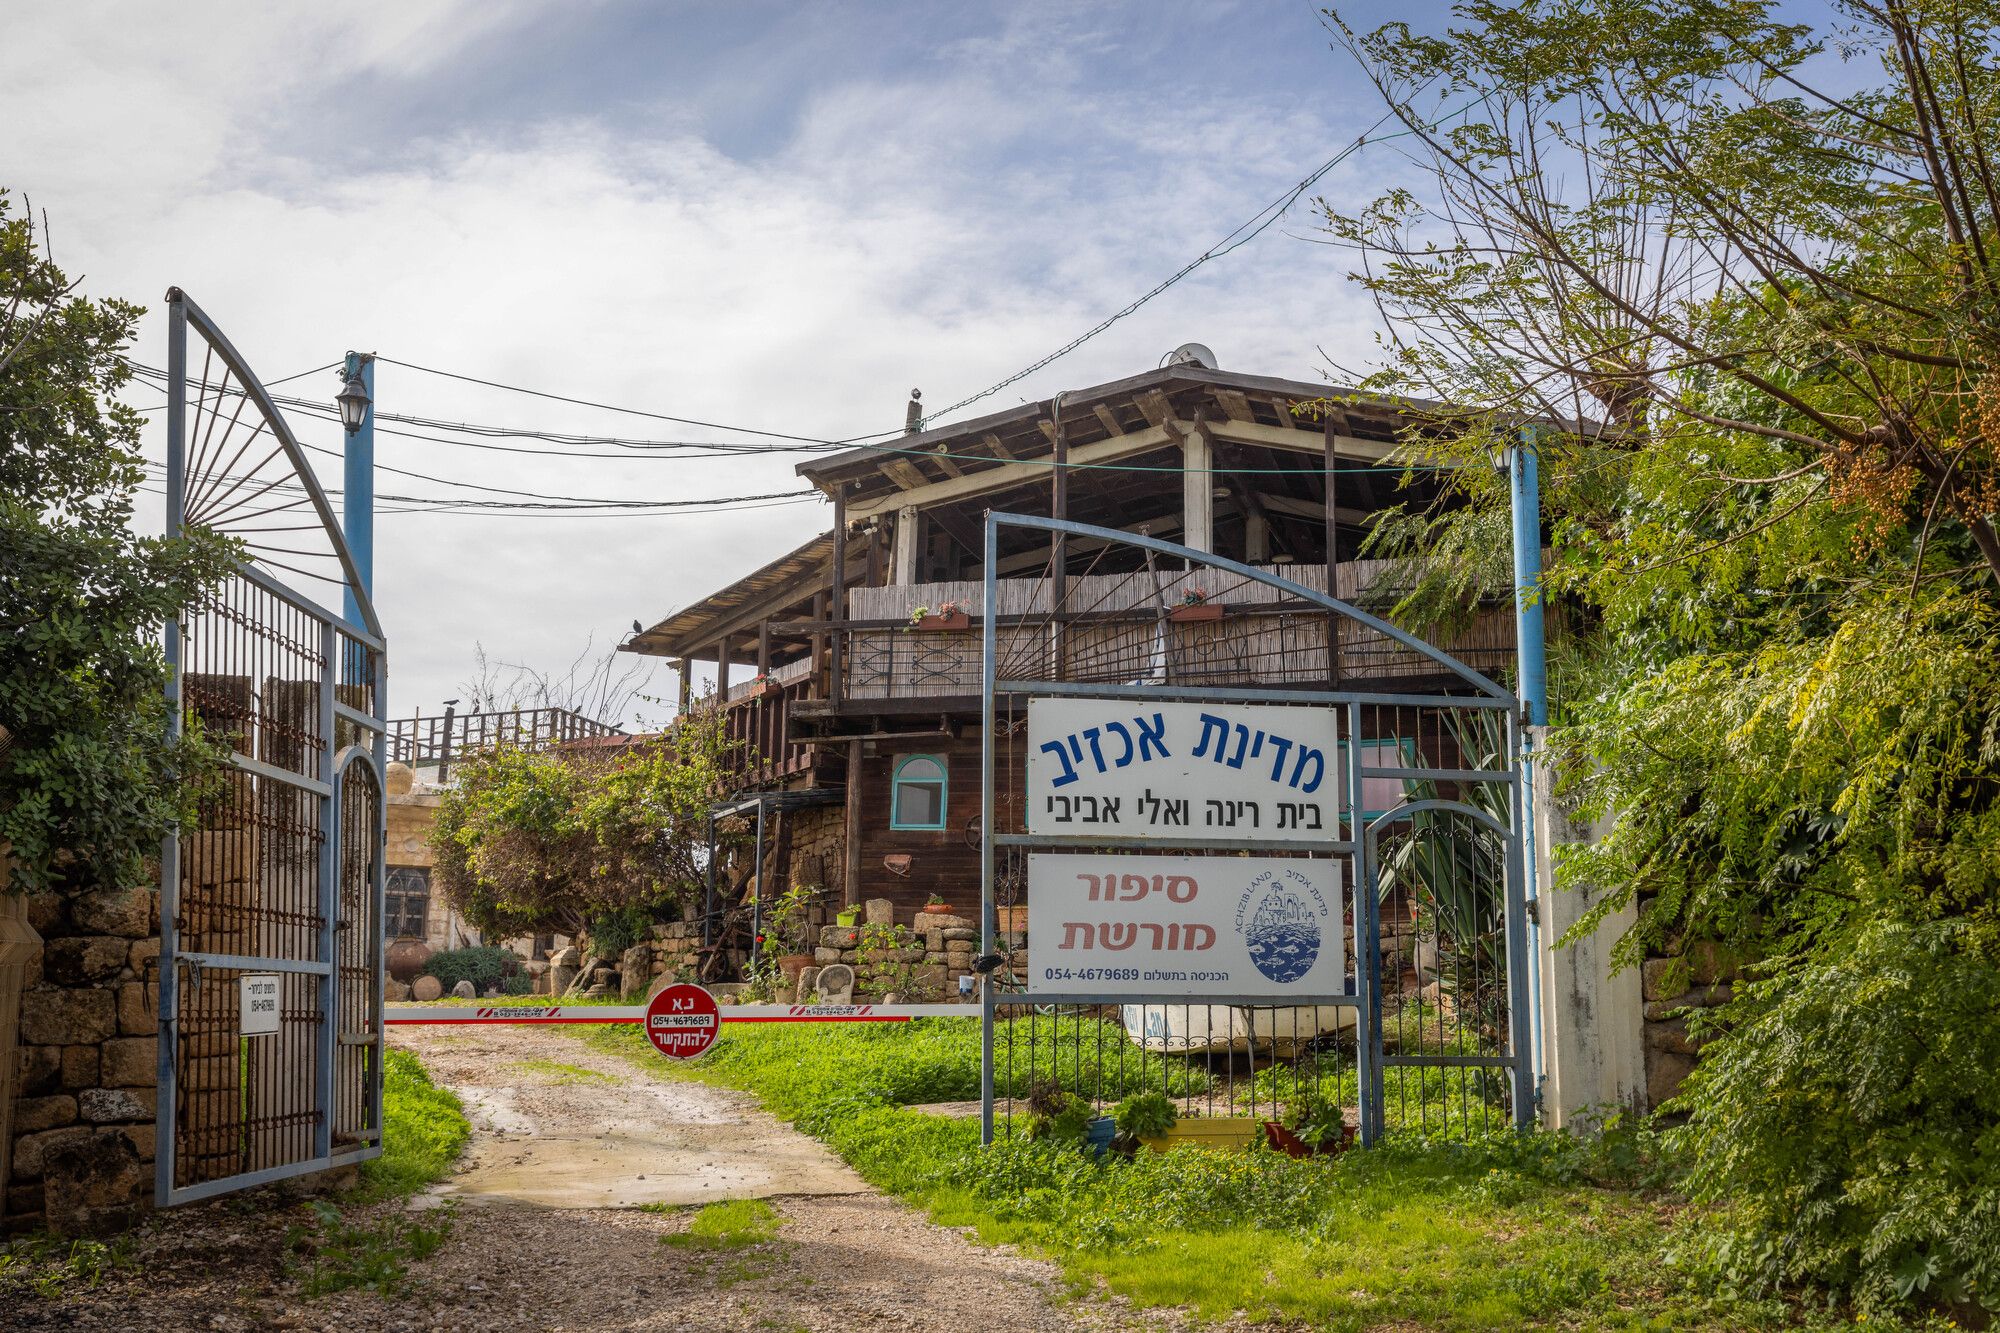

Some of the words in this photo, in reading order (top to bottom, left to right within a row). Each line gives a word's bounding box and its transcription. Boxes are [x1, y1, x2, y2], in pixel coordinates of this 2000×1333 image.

[1040, 712, 1172, 788] אכזיב
[1191, 712, 1325, 794] מדינת
[1047, 795, 1120, 823] אביבי
[1137, 788, 1189, 826] ואלי
[1206, 799, 1259, 828] רינה
[1276, 802, 1323, 830] בית
[1076, 873, 1199, 903] סיפור
[1285, 869, 1311, 888] אכזיב
[1235, 893, 1251, 934] ACHZIB
[1247, 870, 1272, 894] LAND
[1310, 887, 1328, 917] מדינת
[1058, 922, 1217, 951] מורשת
[1045, 967, 1139, 981] 054-4679689
[1143, 969, 1187, 981] בתשלום
[1190, 971, 1229, 981] הכניסה
[652, 1016, 710, 1026] 054-4679689
[655, 1028, 710, 1053] להתקשר
